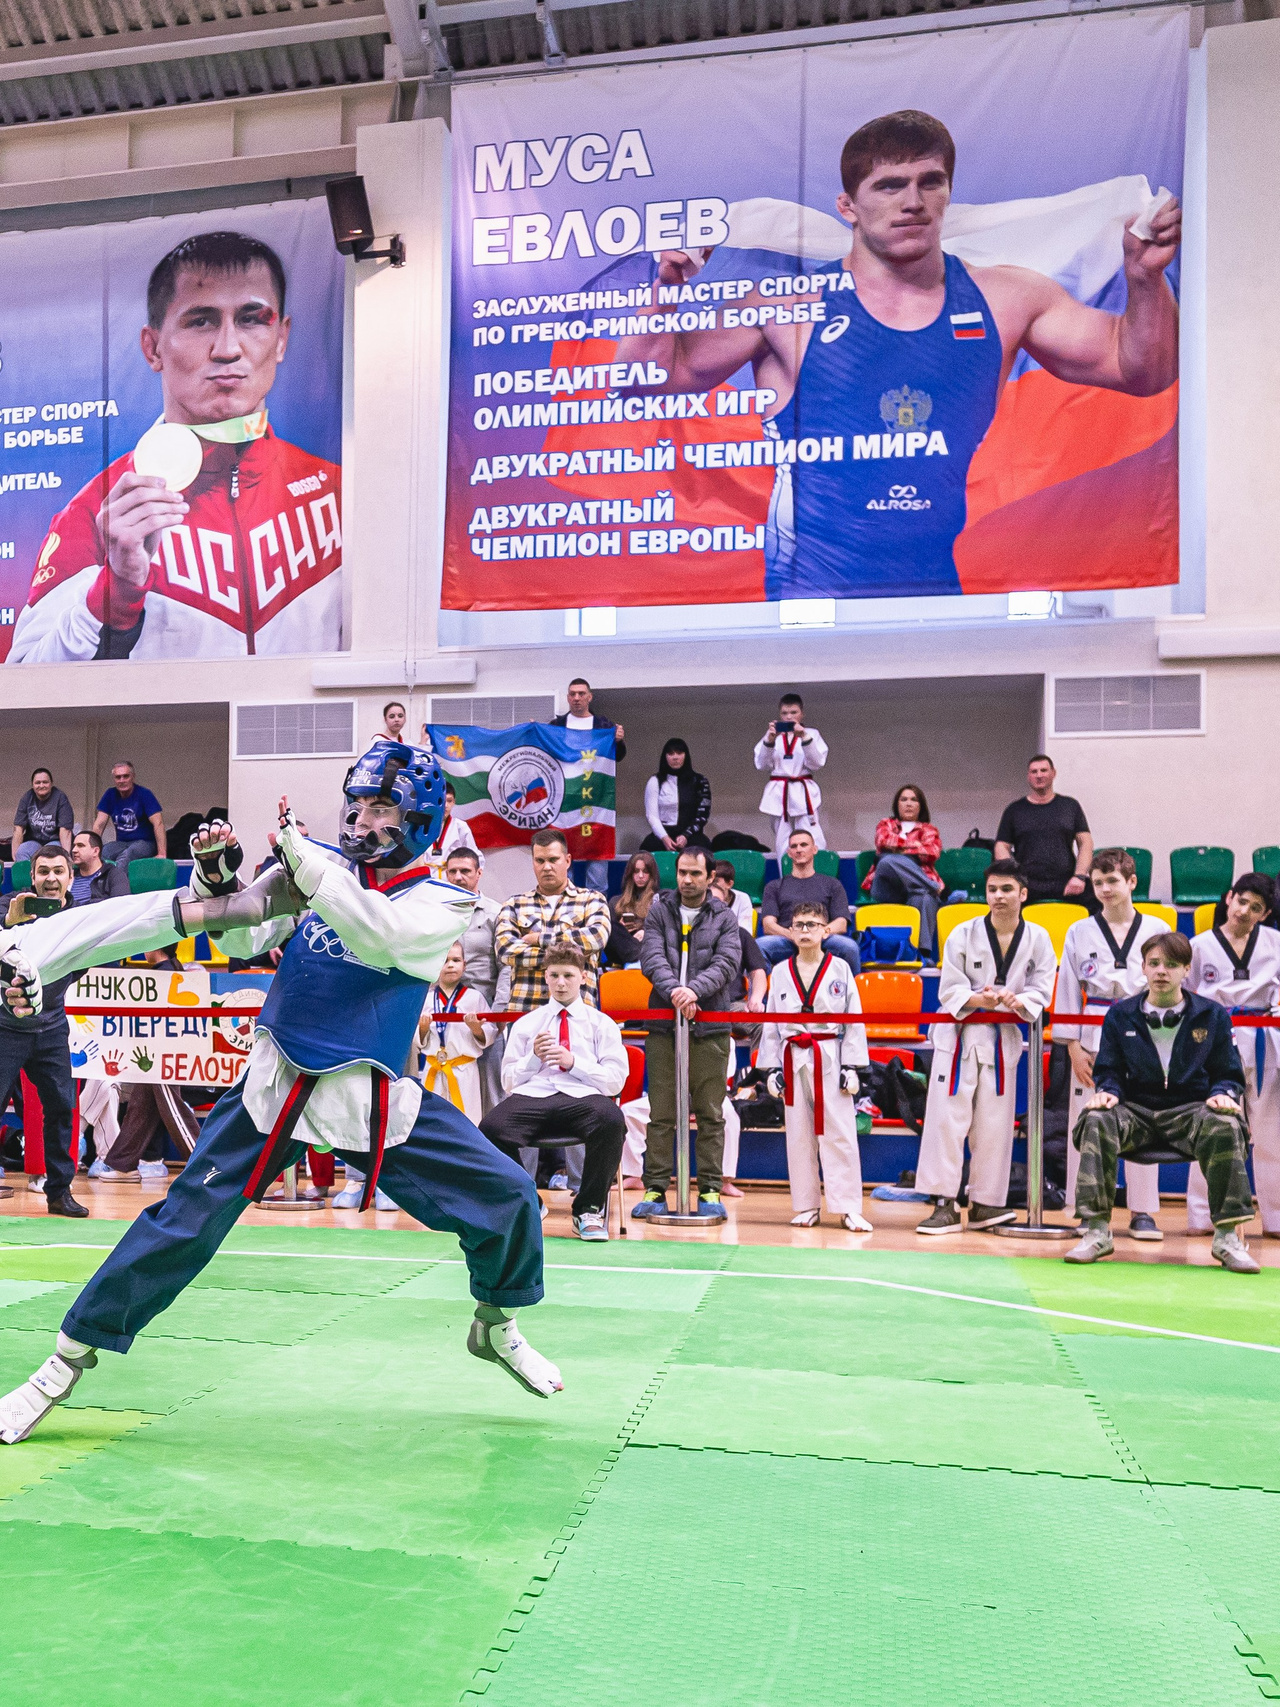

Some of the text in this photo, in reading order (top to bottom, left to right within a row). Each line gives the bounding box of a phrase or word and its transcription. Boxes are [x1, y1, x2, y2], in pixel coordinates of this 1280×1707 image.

[473, 128, 653, 193] МУСА
[471, 197, 730, 266] ЕВЛОЕВ
[472, 270, 855, 319] ЗАСЛУЖЕННЫЙ МАСТЕР СПОРТА
[472, 302, 826, 347] ПО ГРЕКО-РИМСКОЙ БОРЬБЕ
[473, 360, 668, 398] ПОБЕДИТЕЛЬ
[42, 399, 119, 422] СПОРТА
[473, 387, 777, 432] ОЛИМПИЙСКИХ ИГР
[4, 426, 83, 449] БОРЬБЕ
[470, 430, 949, 485] ДВУКРАТНЫЙ ЧЕМПИОН МИРА
[469, 489, 674, 534] ДВУКРАТНЫЙ
[866, 499, 931, 510] ALROSA
[150, 492, 342, 614] ОССИЯ
[470, 524, 766, 562] ЧЕМПИОН ЕВРОПЫ
[580, 749, 598, 837] ЖУКОВ
[499, 805, 554, 828] ЭРИДАН
[76, 975, 158, 1002] ЖУКОВ
